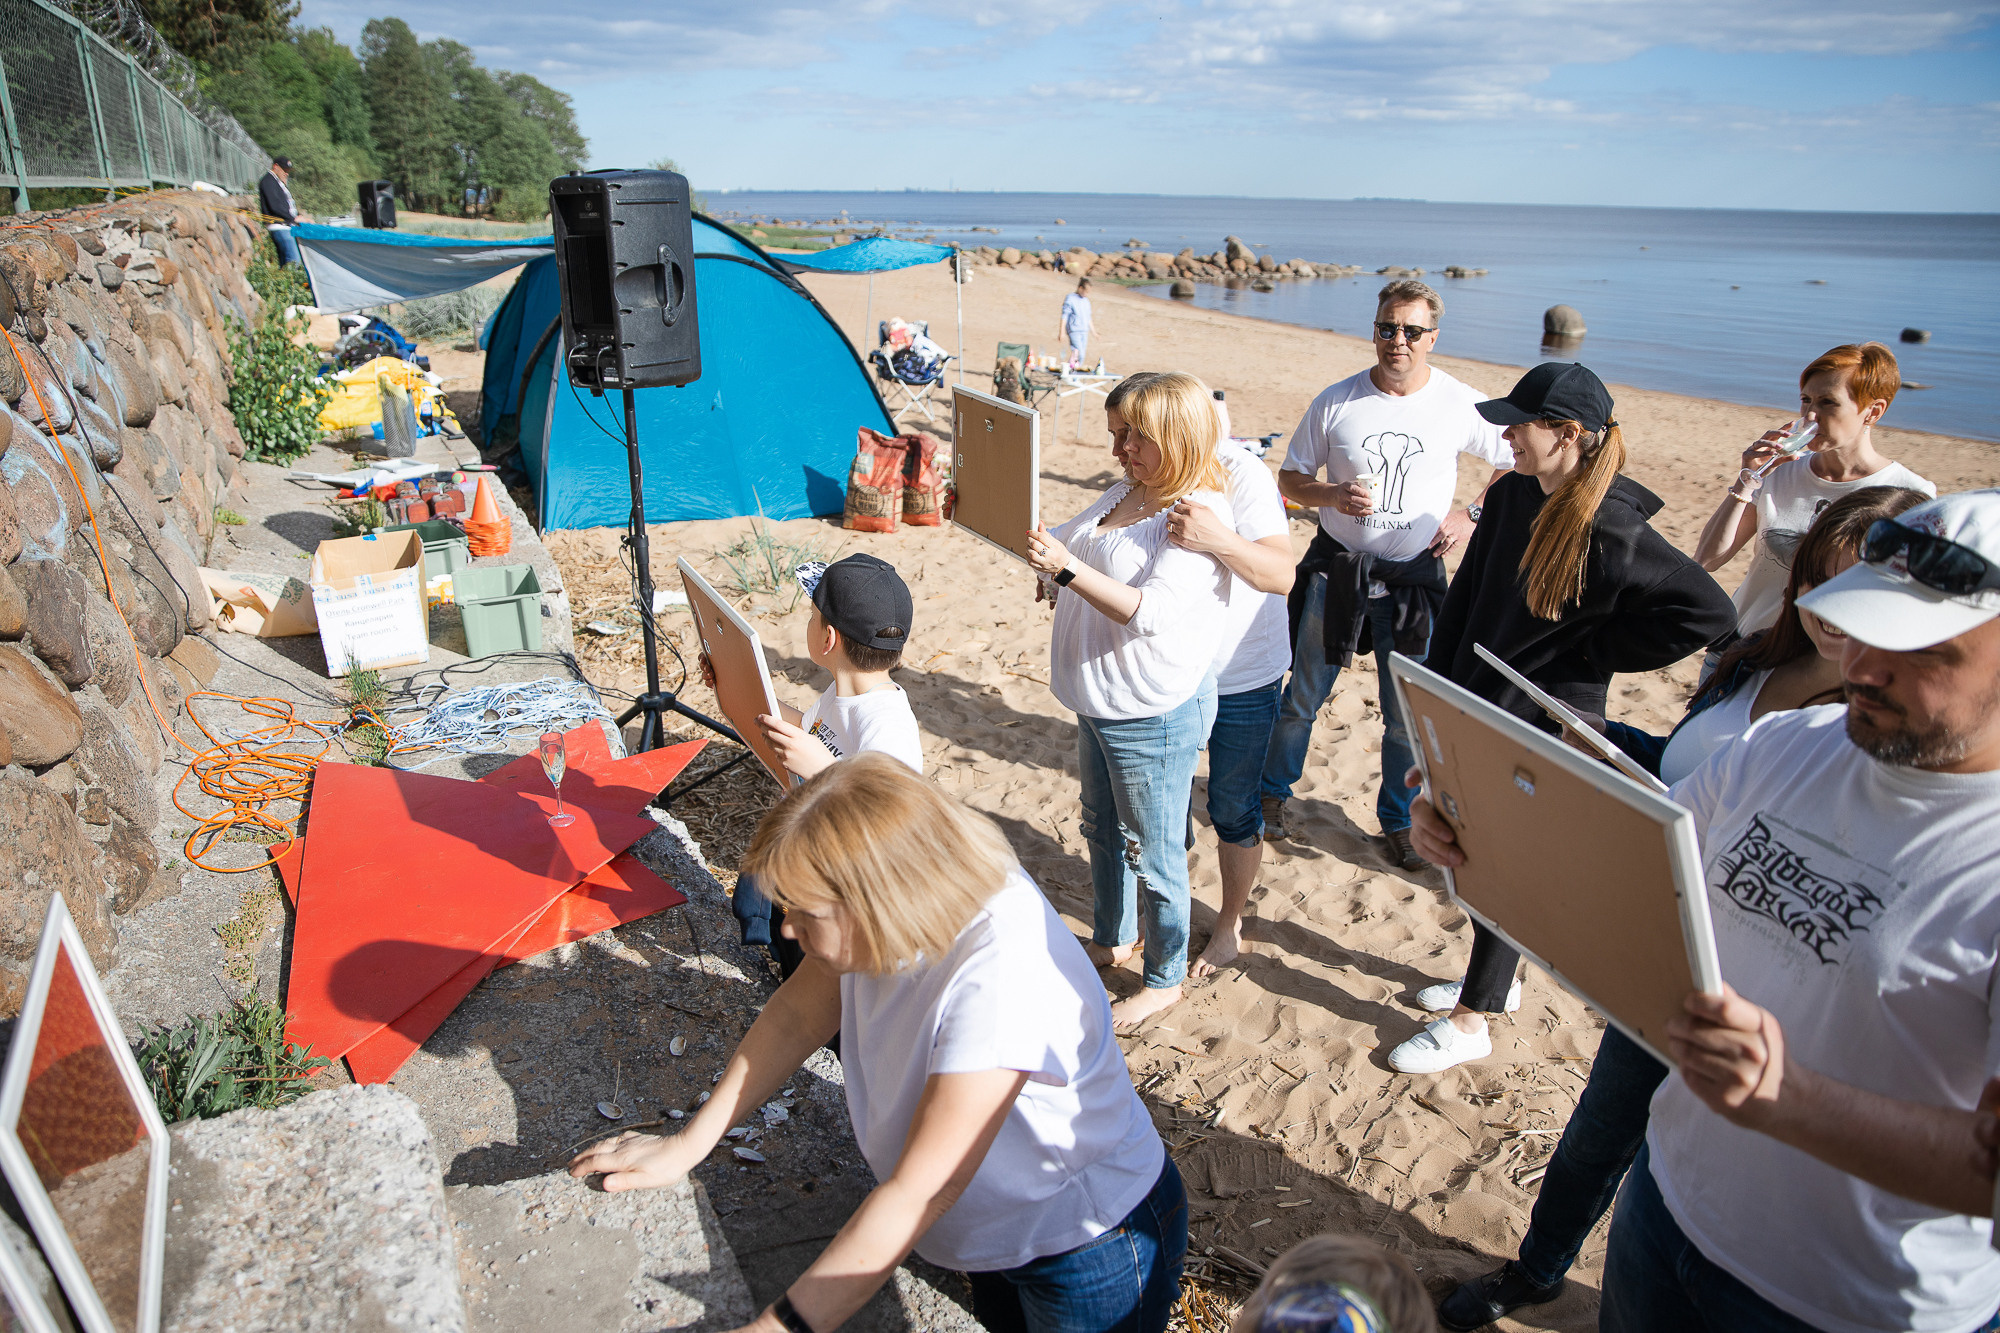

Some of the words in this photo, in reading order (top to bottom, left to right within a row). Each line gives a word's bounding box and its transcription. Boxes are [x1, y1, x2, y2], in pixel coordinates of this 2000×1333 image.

[1354, 516, 1370, 527] SRI
[1373, 519, 1412, 530] LANKA
[347, 631, 369, 641] Team
[370, 627, 390, 637] room
